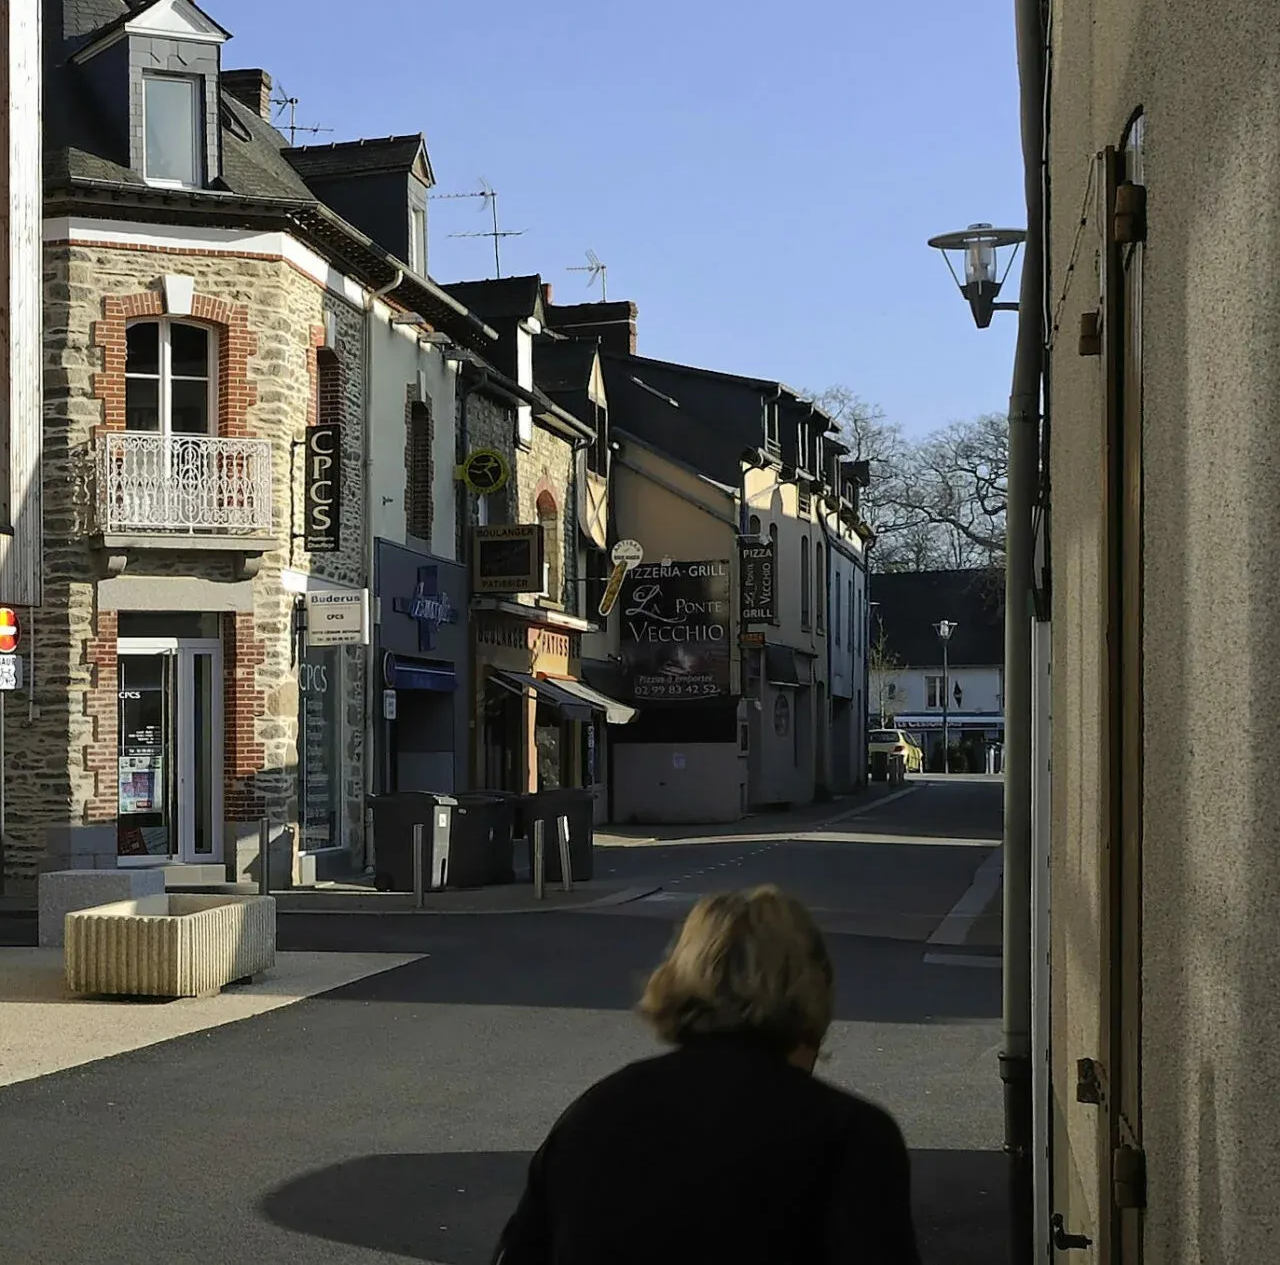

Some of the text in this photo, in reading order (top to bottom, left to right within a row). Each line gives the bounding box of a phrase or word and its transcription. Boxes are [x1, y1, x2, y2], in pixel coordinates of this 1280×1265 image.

[310, 430, 334, 530] CPCS
[477, 528, 533, 537] BOULANGER
[743, 548, 773, 559] PIZZA
[311, 595, 361, 603] Buderus
[743, 608, 773, 618] GRILL
[299, 663, 328, 694] CPCS
[118, 691, 141, 700] CPCS
